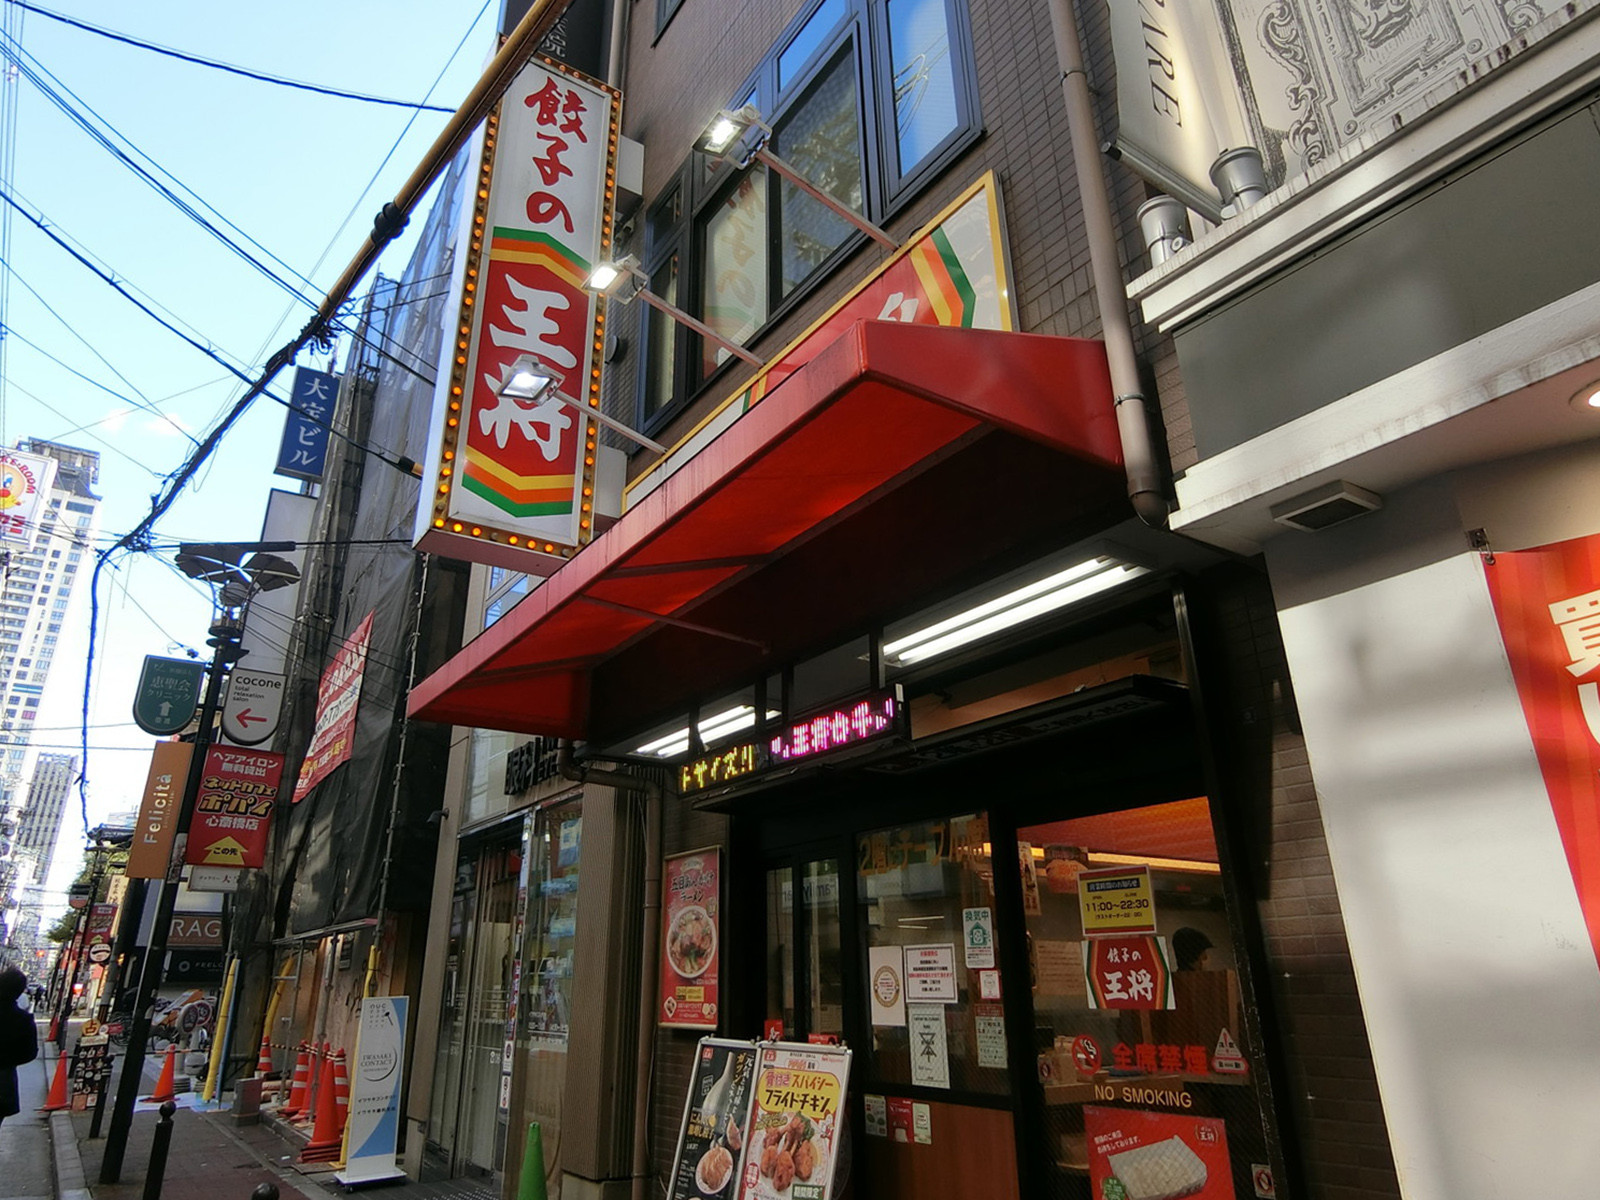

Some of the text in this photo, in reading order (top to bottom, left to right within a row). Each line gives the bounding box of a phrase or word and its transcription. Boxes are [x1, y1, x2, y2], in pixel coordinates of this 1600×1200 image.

[289, 377, 329, 466] 大宝ビル
[235, 675, 282, 689] cocone
[213, 752, 279, 768] ヘアアイロン
[198, 793, 273, 818] ポパイ
[212, 847, 239, 856] この先
[965, 910, 990, 922] 換気中
[1107, 947, 1142, 963] 餃子の
[1103, 968, 1154, 1002] 王将
[1112, 1042, 1209, 1076] 全席禁煙
[765, 1089, 831, 1113] フライドチキン
[1095, 1085, 1193, 1108] NO SMOKING
